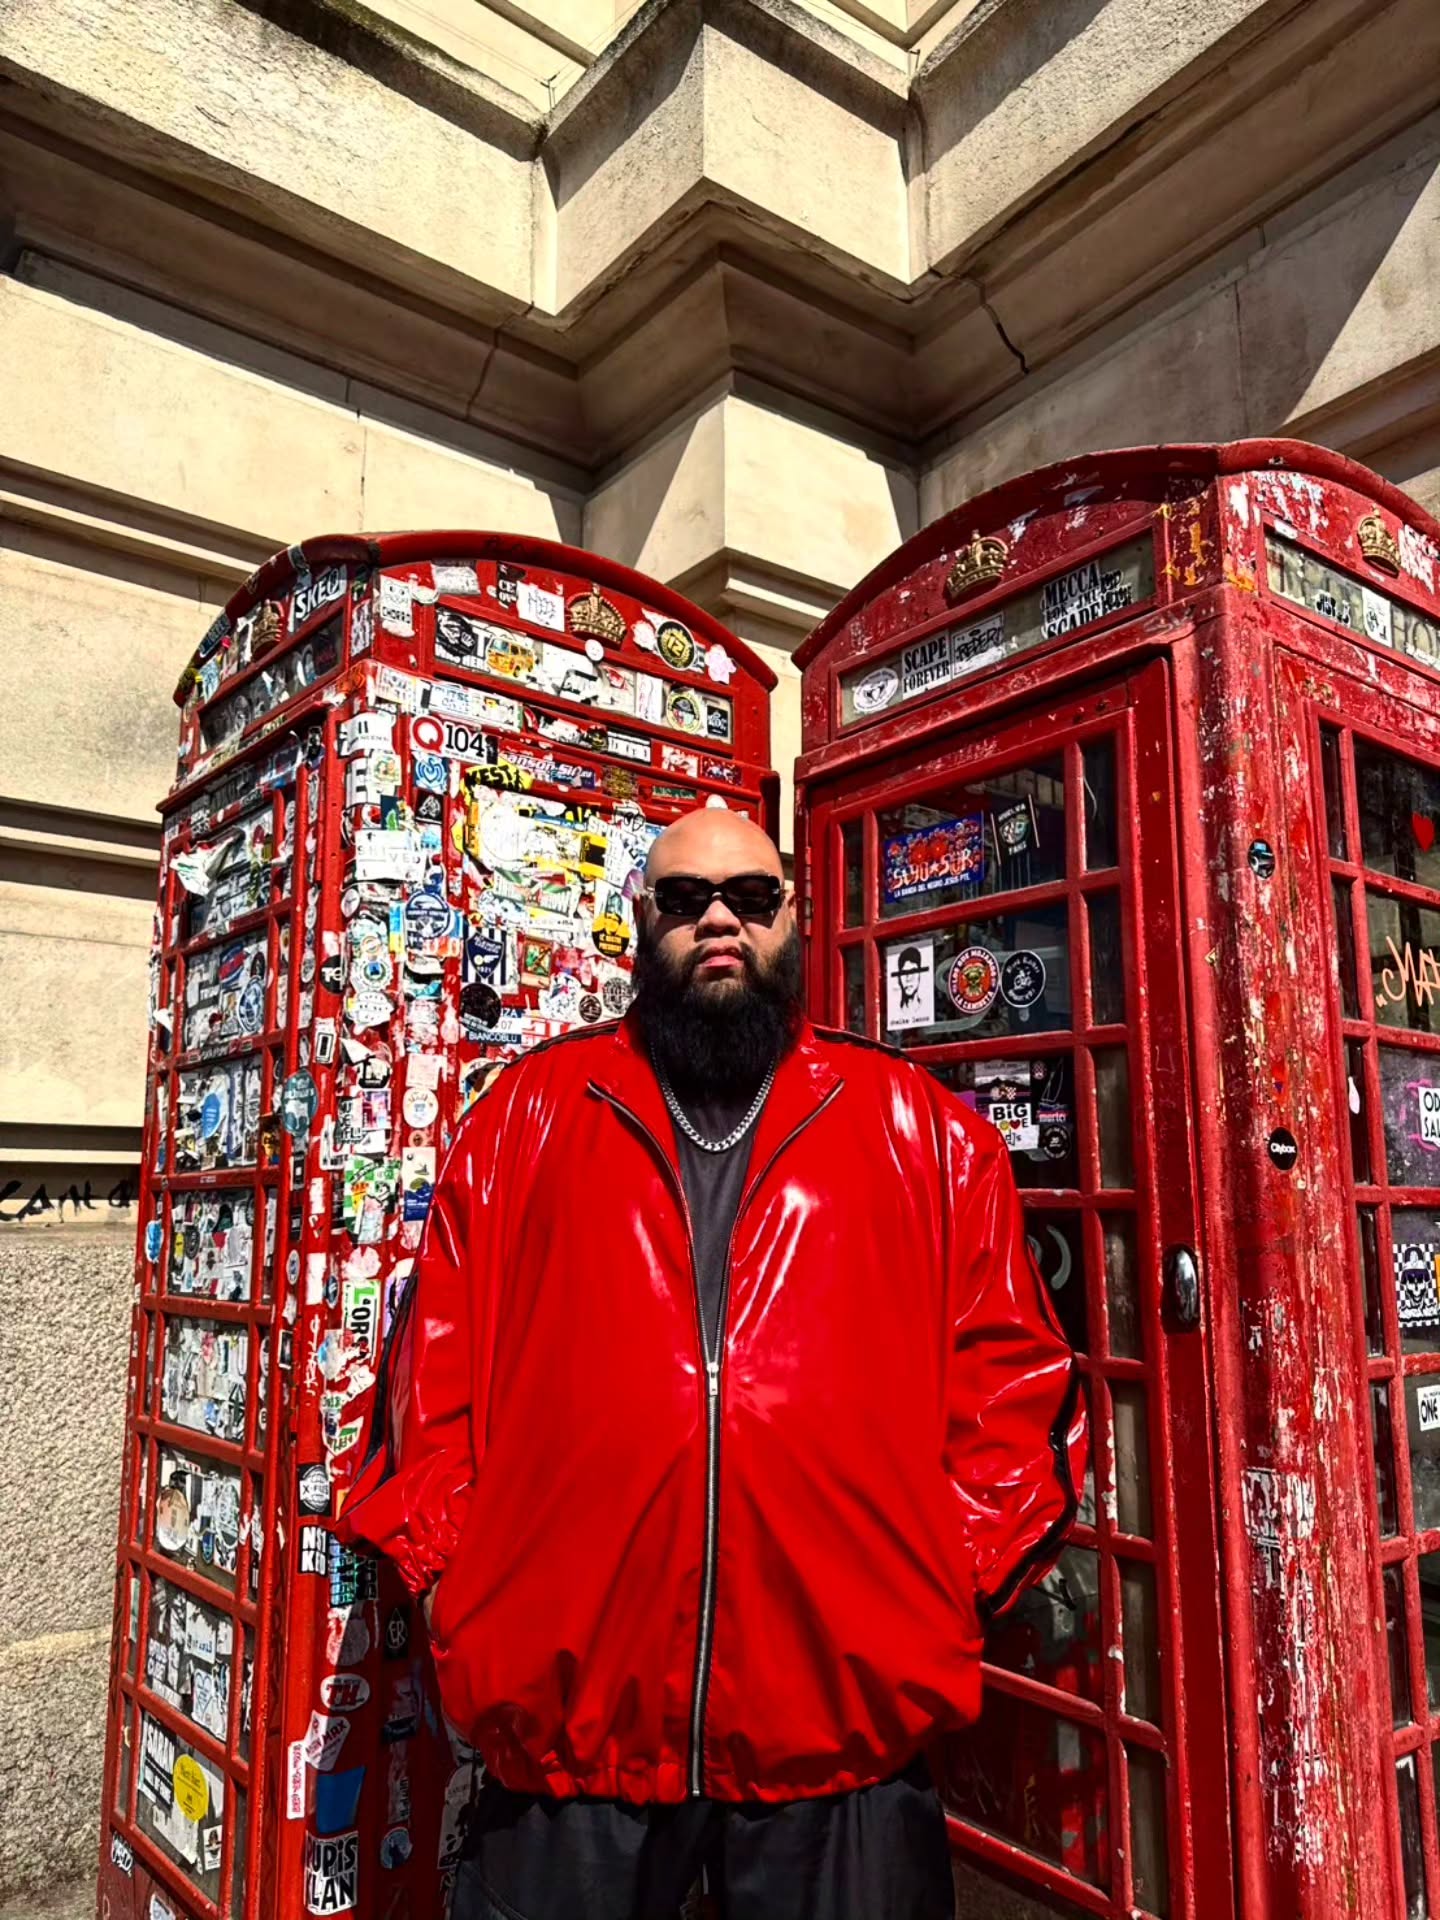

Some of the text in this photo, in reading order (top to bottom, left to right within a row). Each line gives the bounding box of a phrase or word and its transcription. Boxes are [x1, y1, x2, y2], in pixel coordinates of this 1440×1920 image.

[1045, 563, 1099, 607] MECCA
[904, 636, 946, 673] SCAPE
[904, 660, 950, 693] FOREVER
